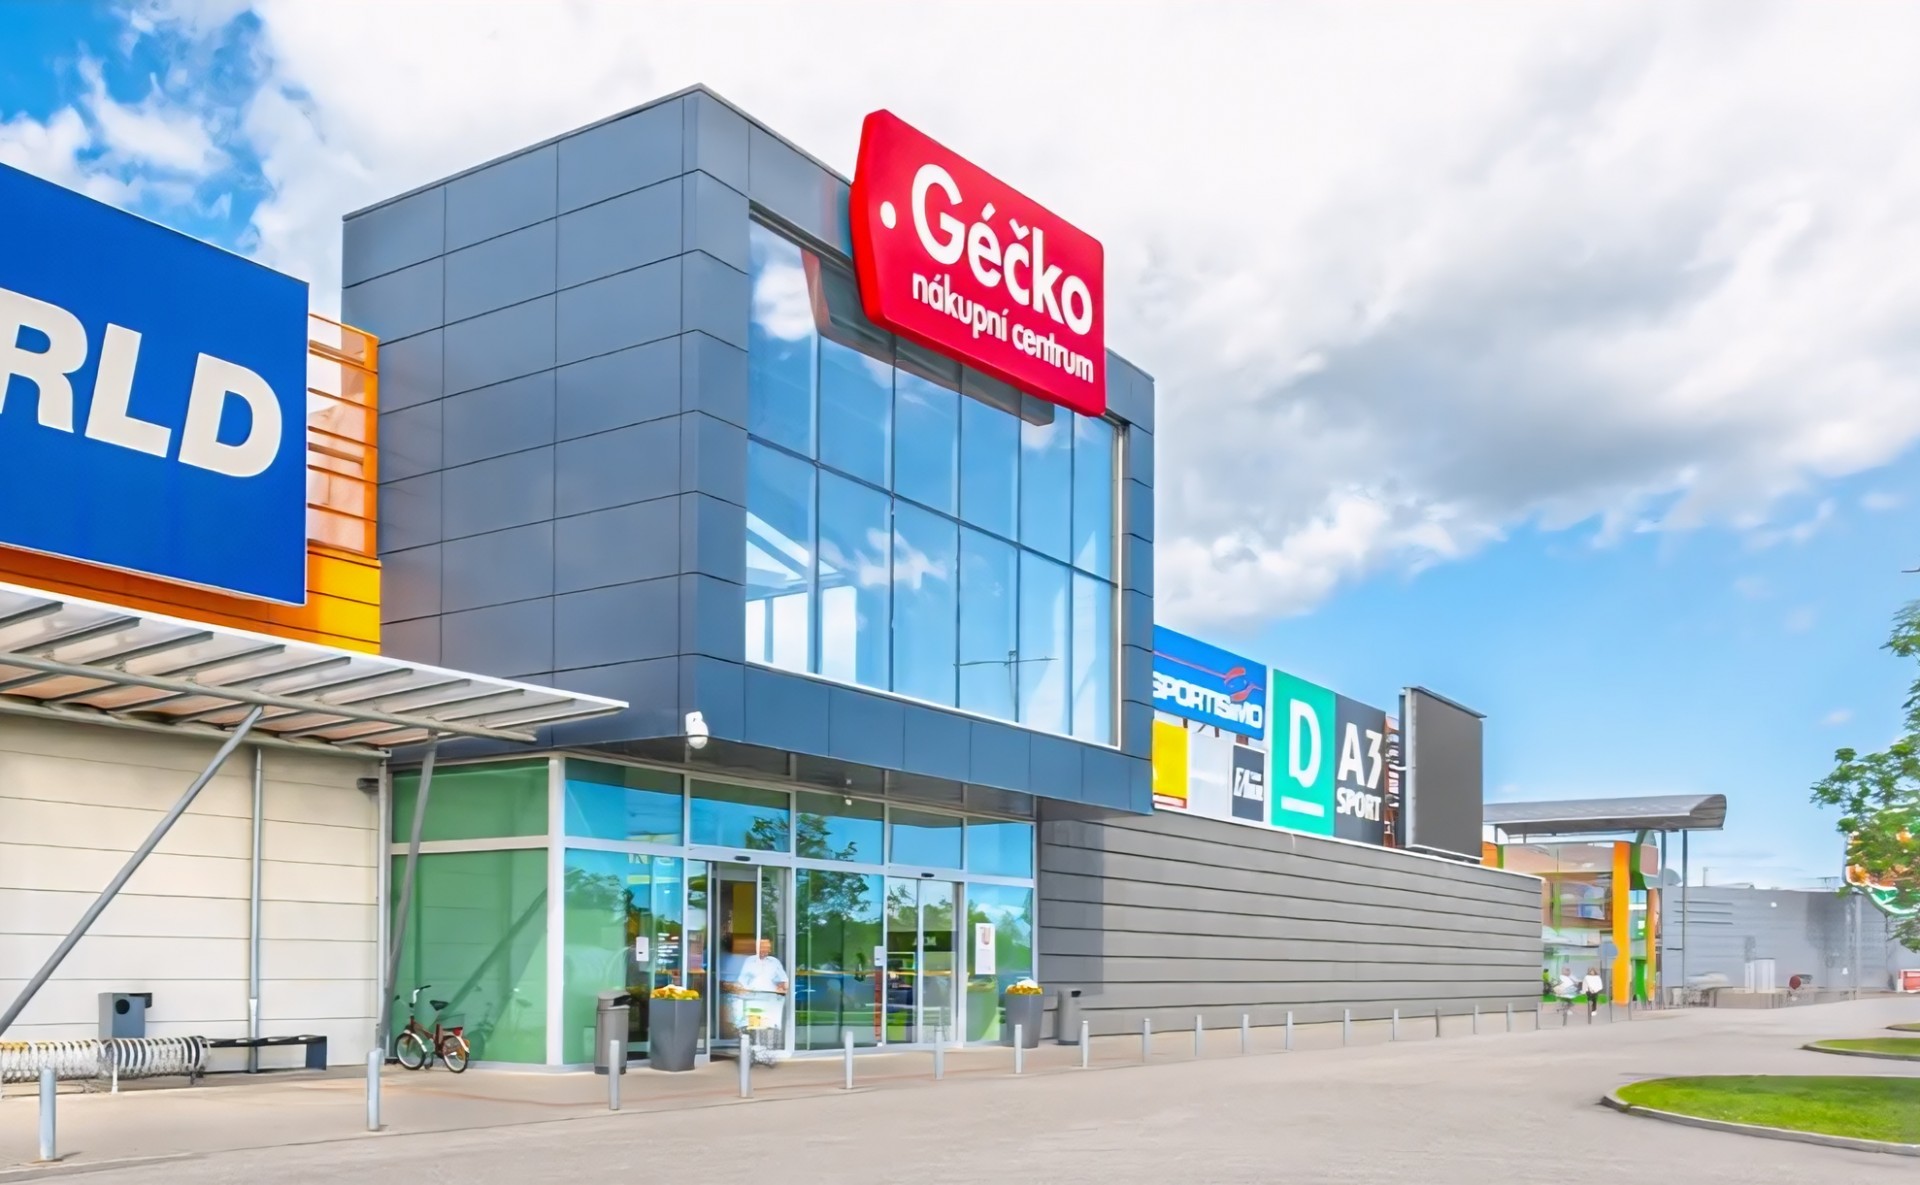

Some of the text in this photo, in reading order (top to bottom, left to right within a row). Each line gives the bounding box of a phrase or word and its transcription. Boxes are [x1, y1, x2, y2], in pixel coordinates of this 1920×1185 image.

[912, 163, 1093, 336] Géčko
[0, 287, 283, 478] RLD
[912, 272, 1094, 384] nákupní centrum
[1336, 787, 1382, 822] SPORT
[1337, 722, 1383, 790] A3
